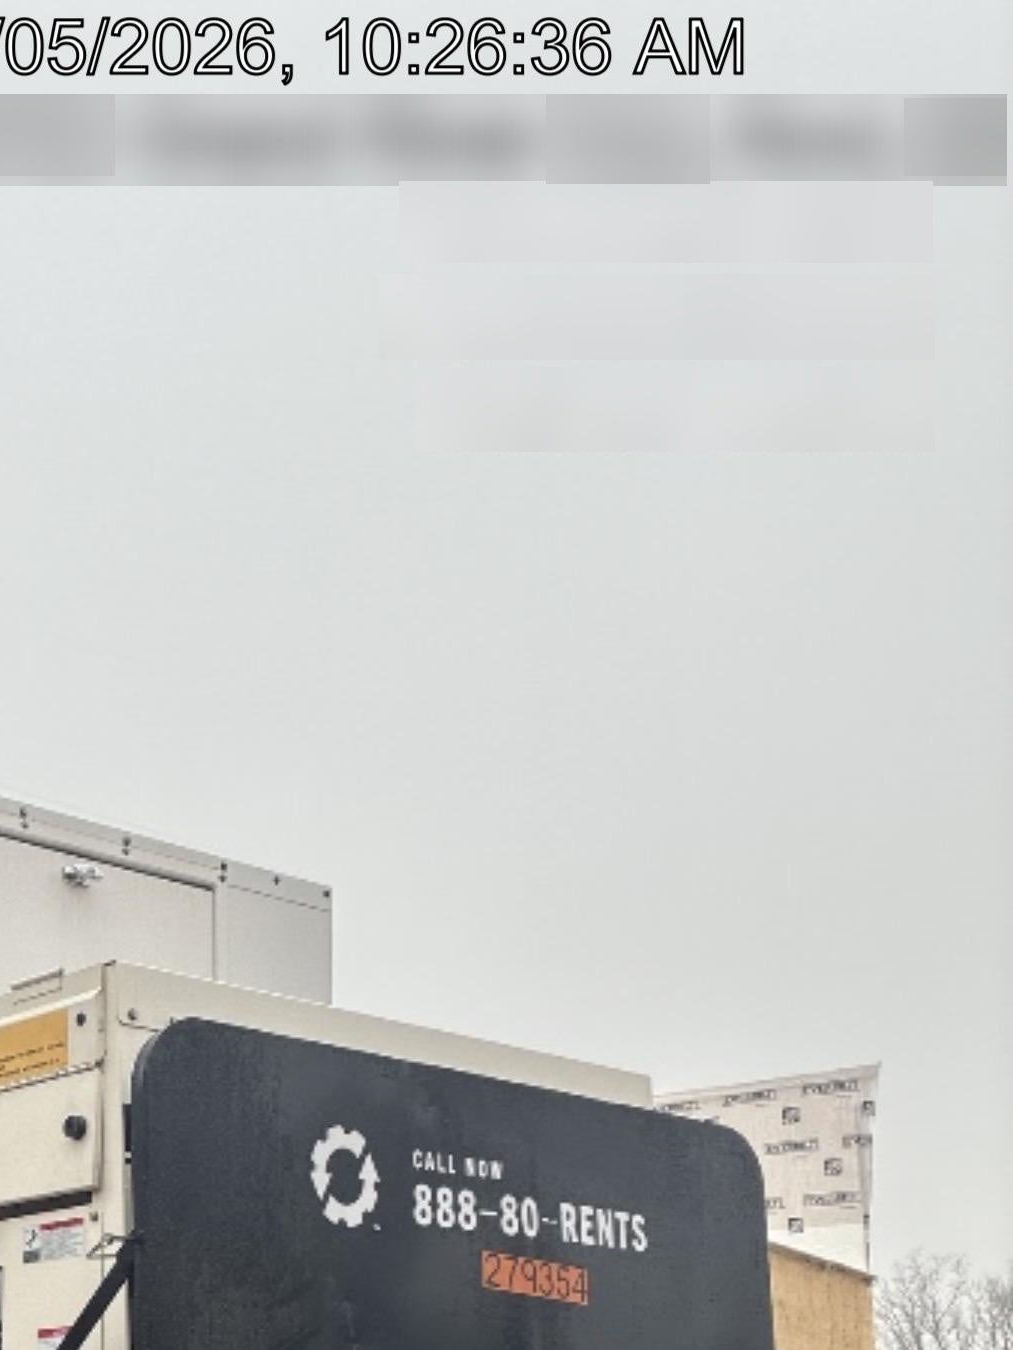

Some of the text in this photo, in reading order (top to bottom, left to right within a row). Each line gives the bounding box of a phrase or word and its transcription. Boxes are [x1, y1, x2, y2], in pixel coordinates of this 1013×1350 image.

[412, 1149, 504, 1180] CALL NOW
[413, 1184, 648, 1252] 888-80-RENTS
[484, 1253, 587, 1302] 279354
